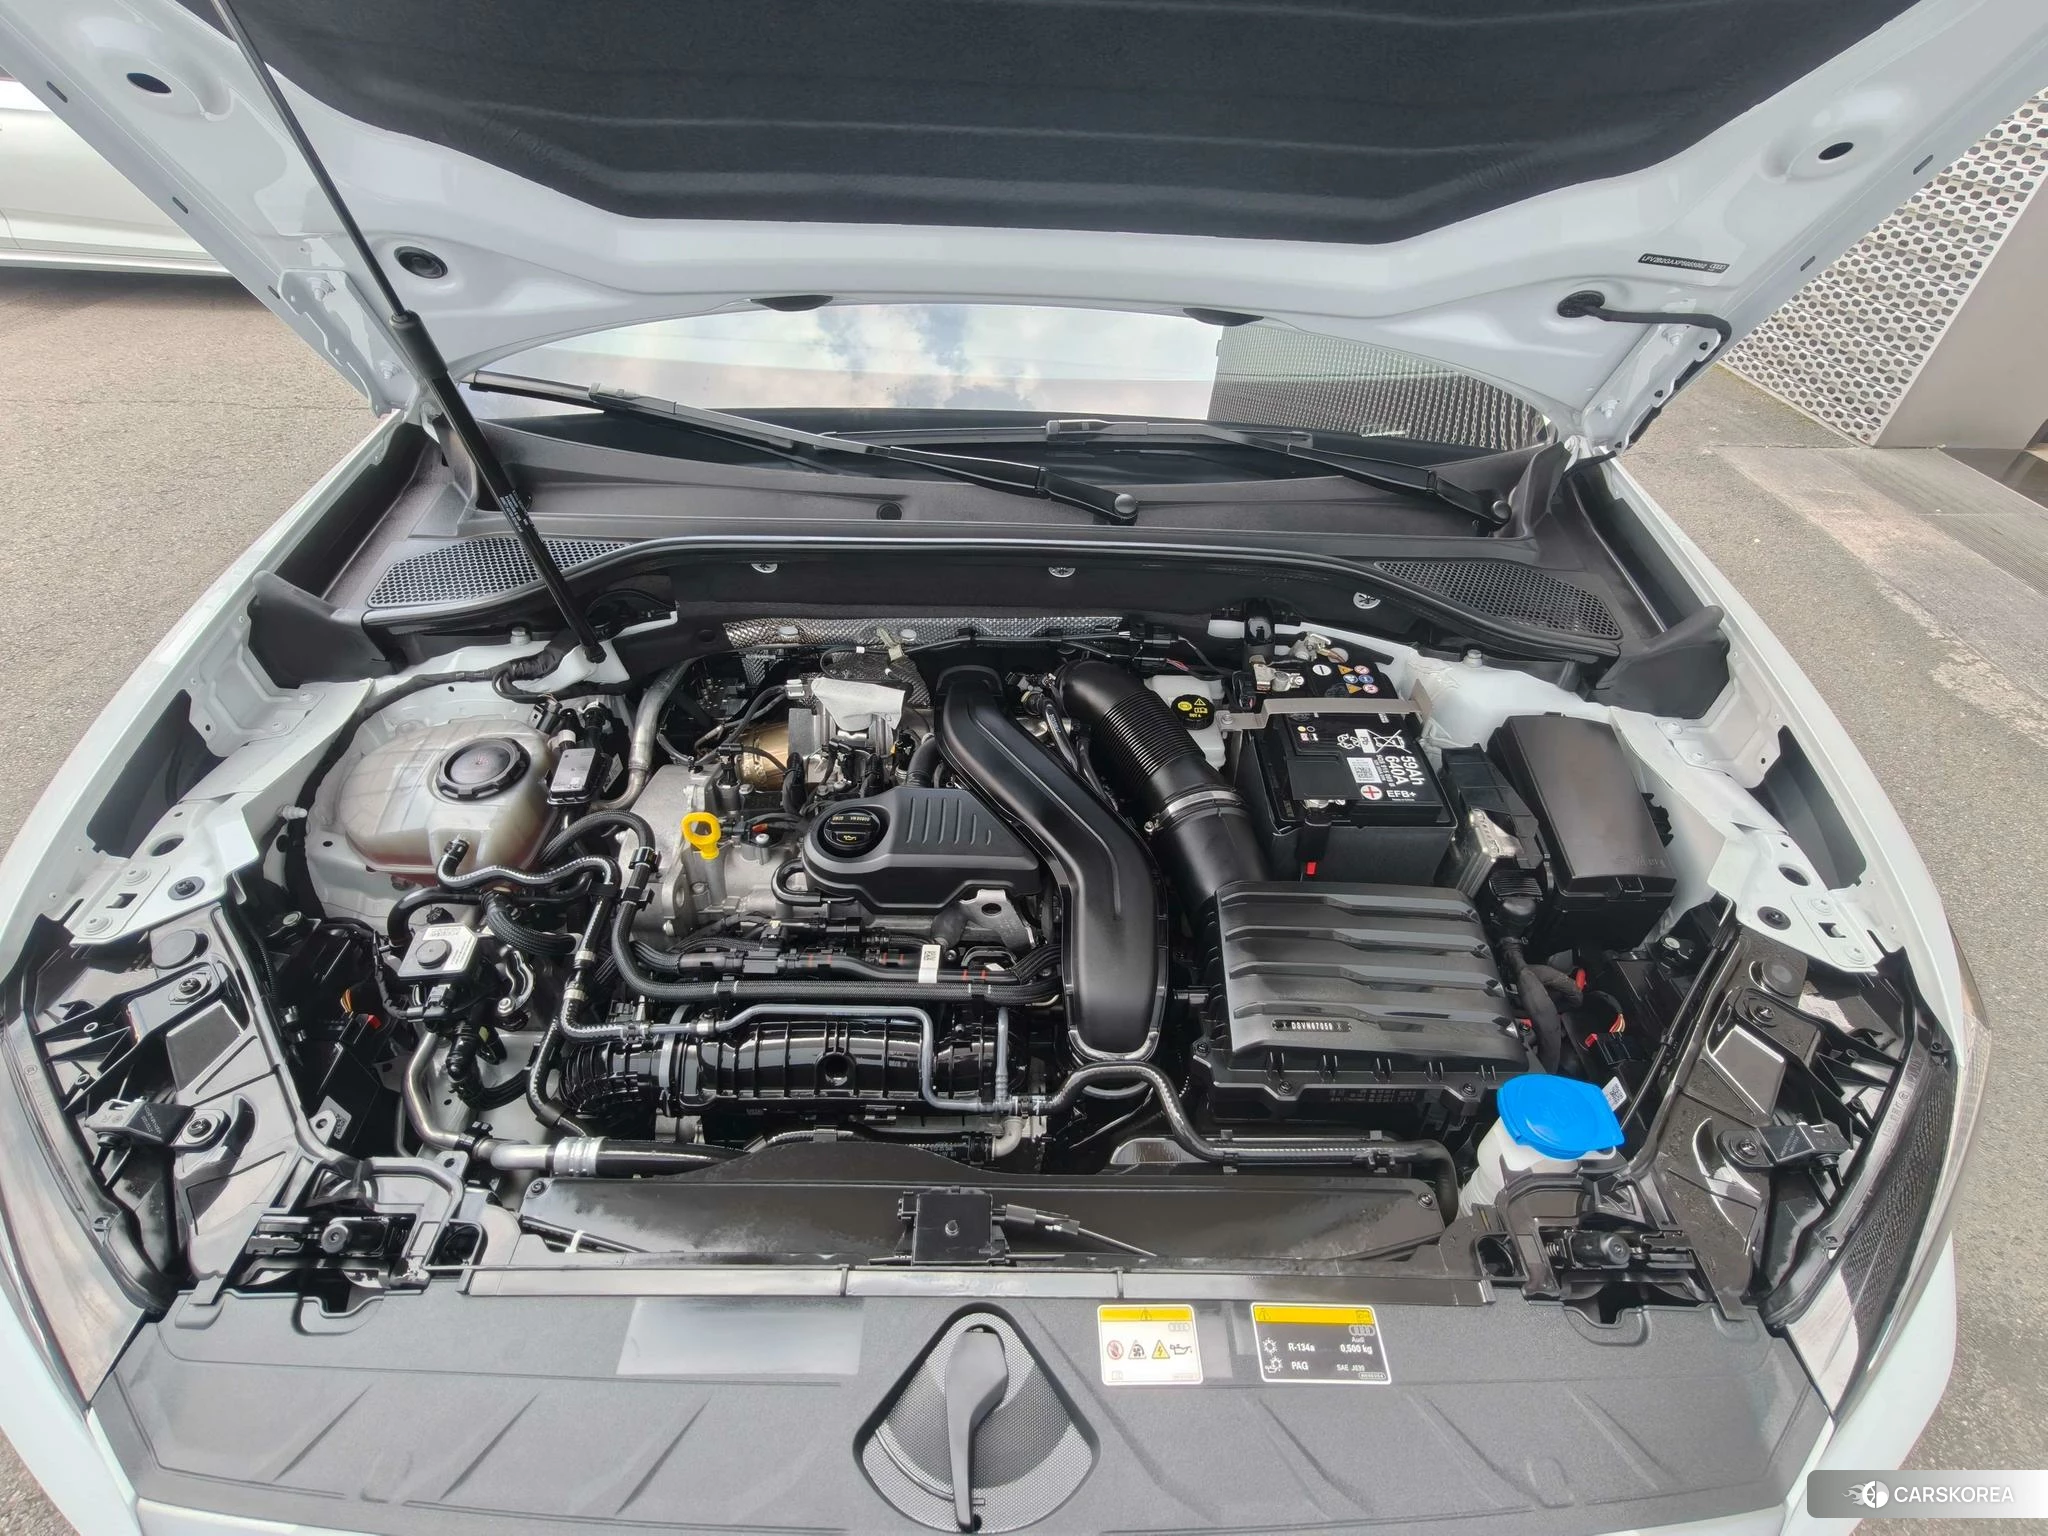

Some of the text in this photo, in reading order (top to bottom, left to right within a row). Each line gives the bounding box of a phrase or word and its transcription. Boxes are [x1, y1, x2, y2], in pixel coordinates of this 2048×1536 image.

[1385, 755, 1410, 785] 640A
[1401, 755, 1425, 785] 59Ah
[1386, 789, 1416, 798] EFB+
[1288, 1342, 1373, 1355] R-134a 0,500 kg
[1291, 1361, 1309, 1370] PAG
[1336, 1363, 1349, 1371] SAE
